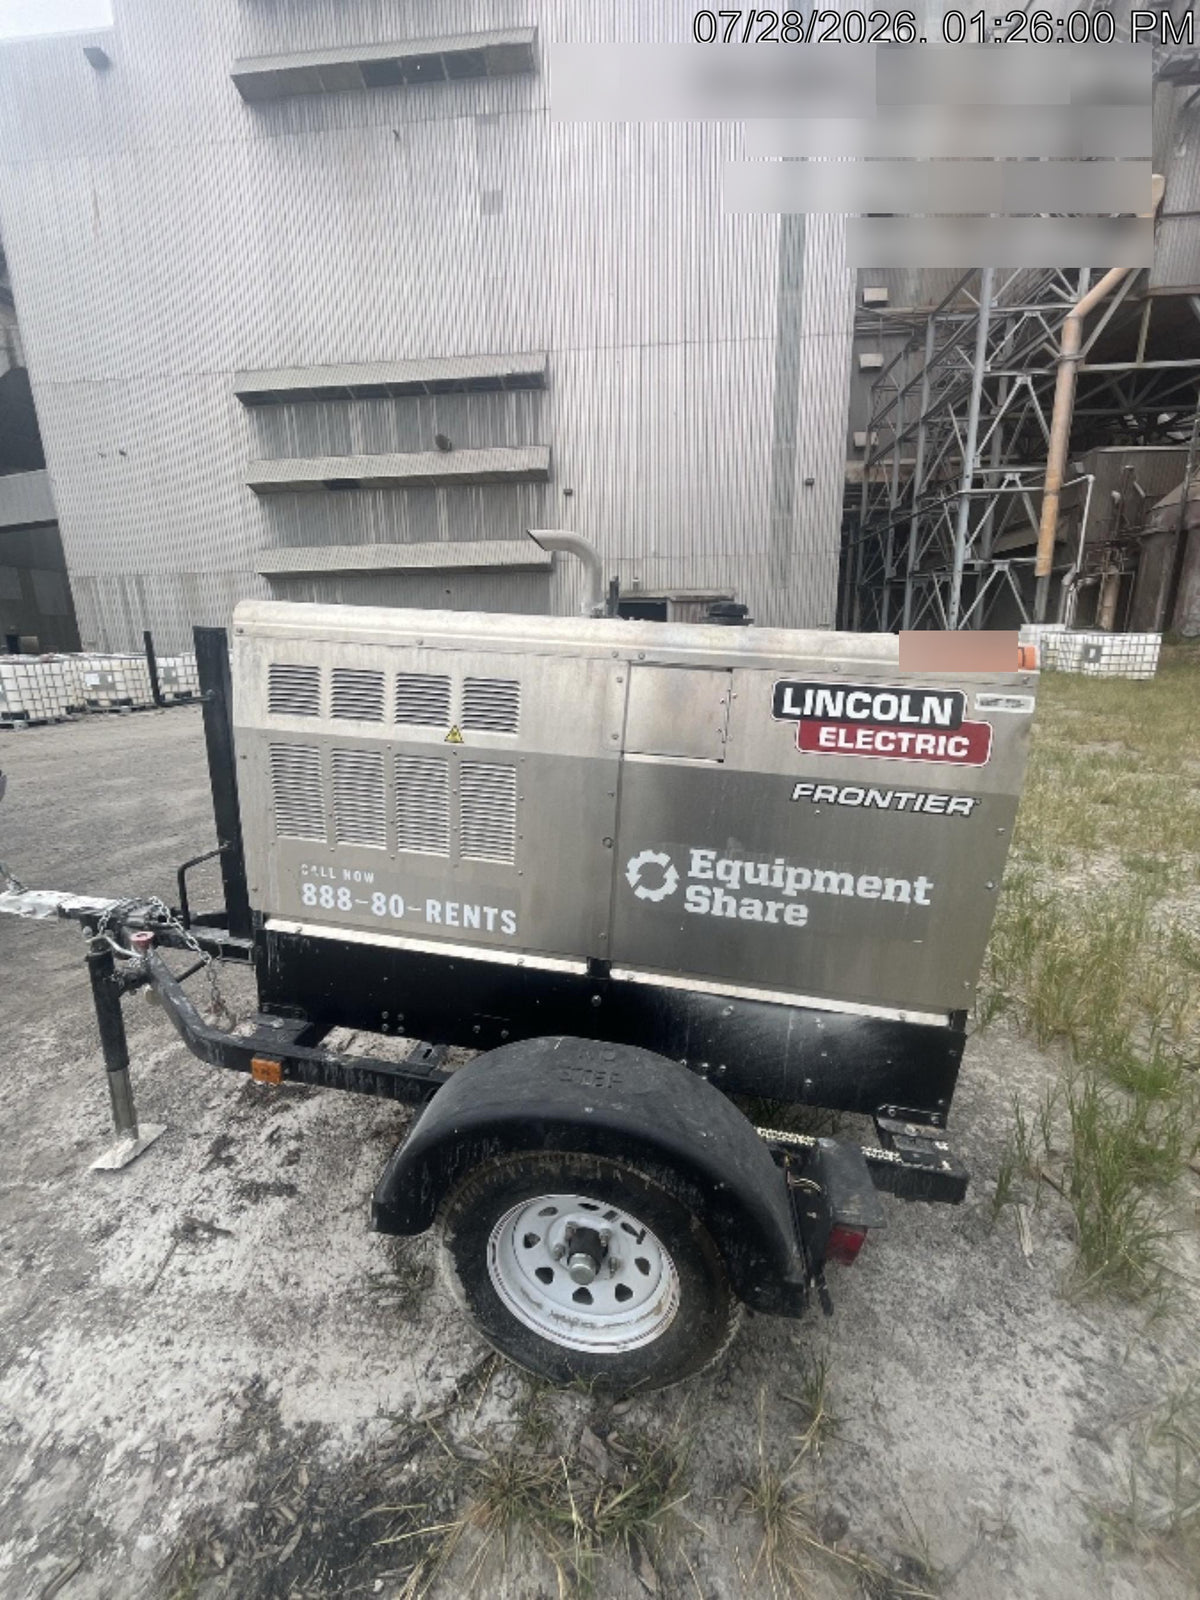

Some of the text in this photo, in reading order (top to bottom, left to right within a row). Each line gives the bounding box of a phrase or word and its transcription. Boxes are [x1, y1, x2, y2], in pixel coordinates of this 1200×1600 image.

[782, 687, 953, 726] LINCOLN
[818, 726, 970, 758] ELECTRIC
[790, 782, 975, 818] FRONTIER
[301, 863, 375, 884] CALL NOW
[688, 848, 934, 906] Equipment
[302, 883, 517, 935] 888-80-RENTS
[684, 885, 809, 927] Share
